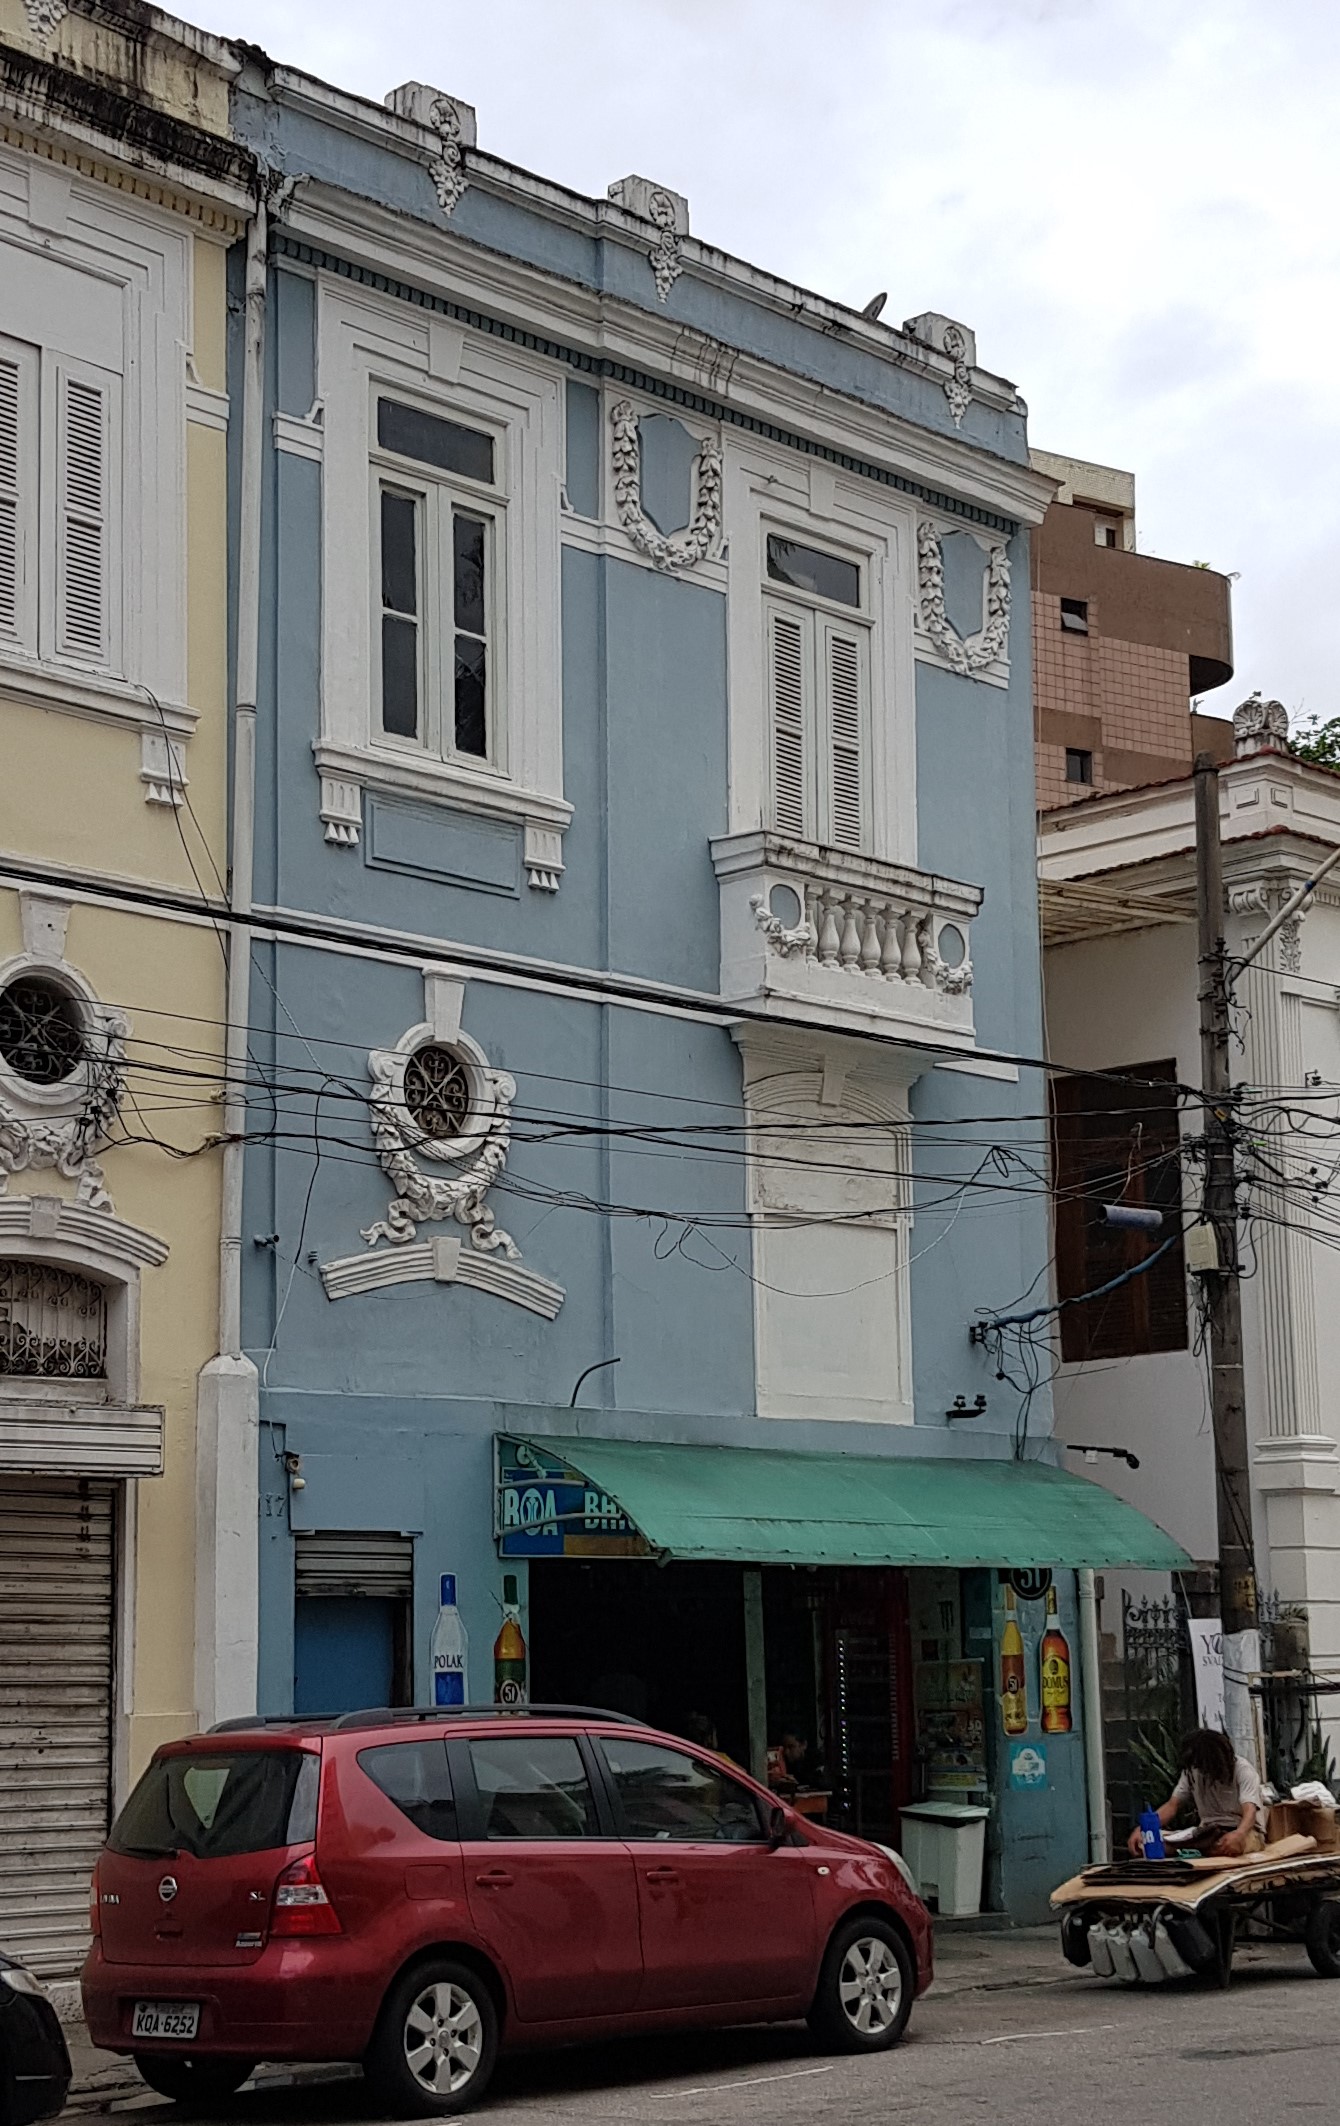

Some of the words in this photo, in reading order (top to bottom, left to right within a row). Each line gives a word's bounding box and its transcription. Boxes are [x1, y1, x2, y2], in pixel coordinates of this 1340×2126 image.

[1020, 1567, 1040, 1588] 51
[434, 1654, 464, 1669] POLAK
[1043, 1675, 1070, 1689] DOMUS
[505, 1685, 515, 1702] 51
